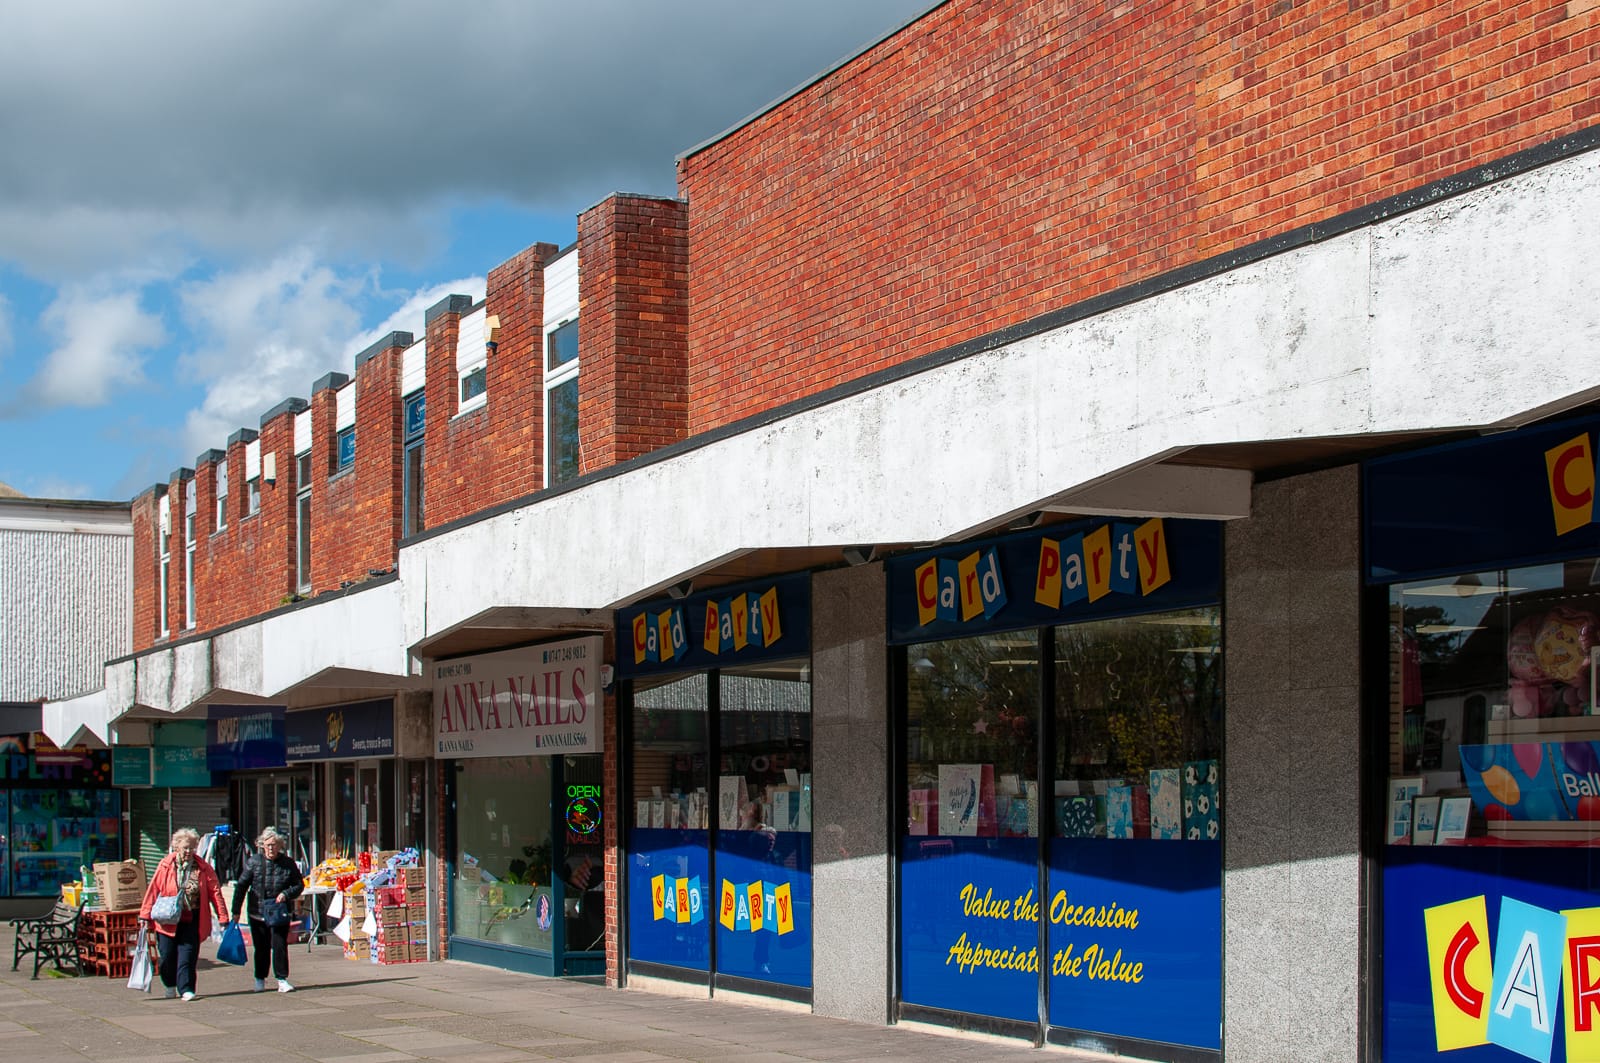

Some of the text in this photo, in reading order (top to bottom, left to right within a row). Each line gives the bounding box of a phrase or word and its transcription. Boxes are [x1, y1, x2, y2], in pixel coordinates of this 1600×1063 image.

[1553, 445, 1592, 510] C
[918, 530, 1159, 609] Card Party
[635, 598, 774, 652] Card Party
[440, 666, 587, 734] ANNA NAILS
[443, 739, 474, 752] ANNA NAILS
[567, 784, 601, 797] OPEN
[566, 831, 600, 846] NAILS
[656, 885, 788, 924] CARD PARTY
[959, 882, 1140, 930] Value the Occasion
[1052, 943, 1083, 978] the
[1083, 943, 1144, 984] Value
